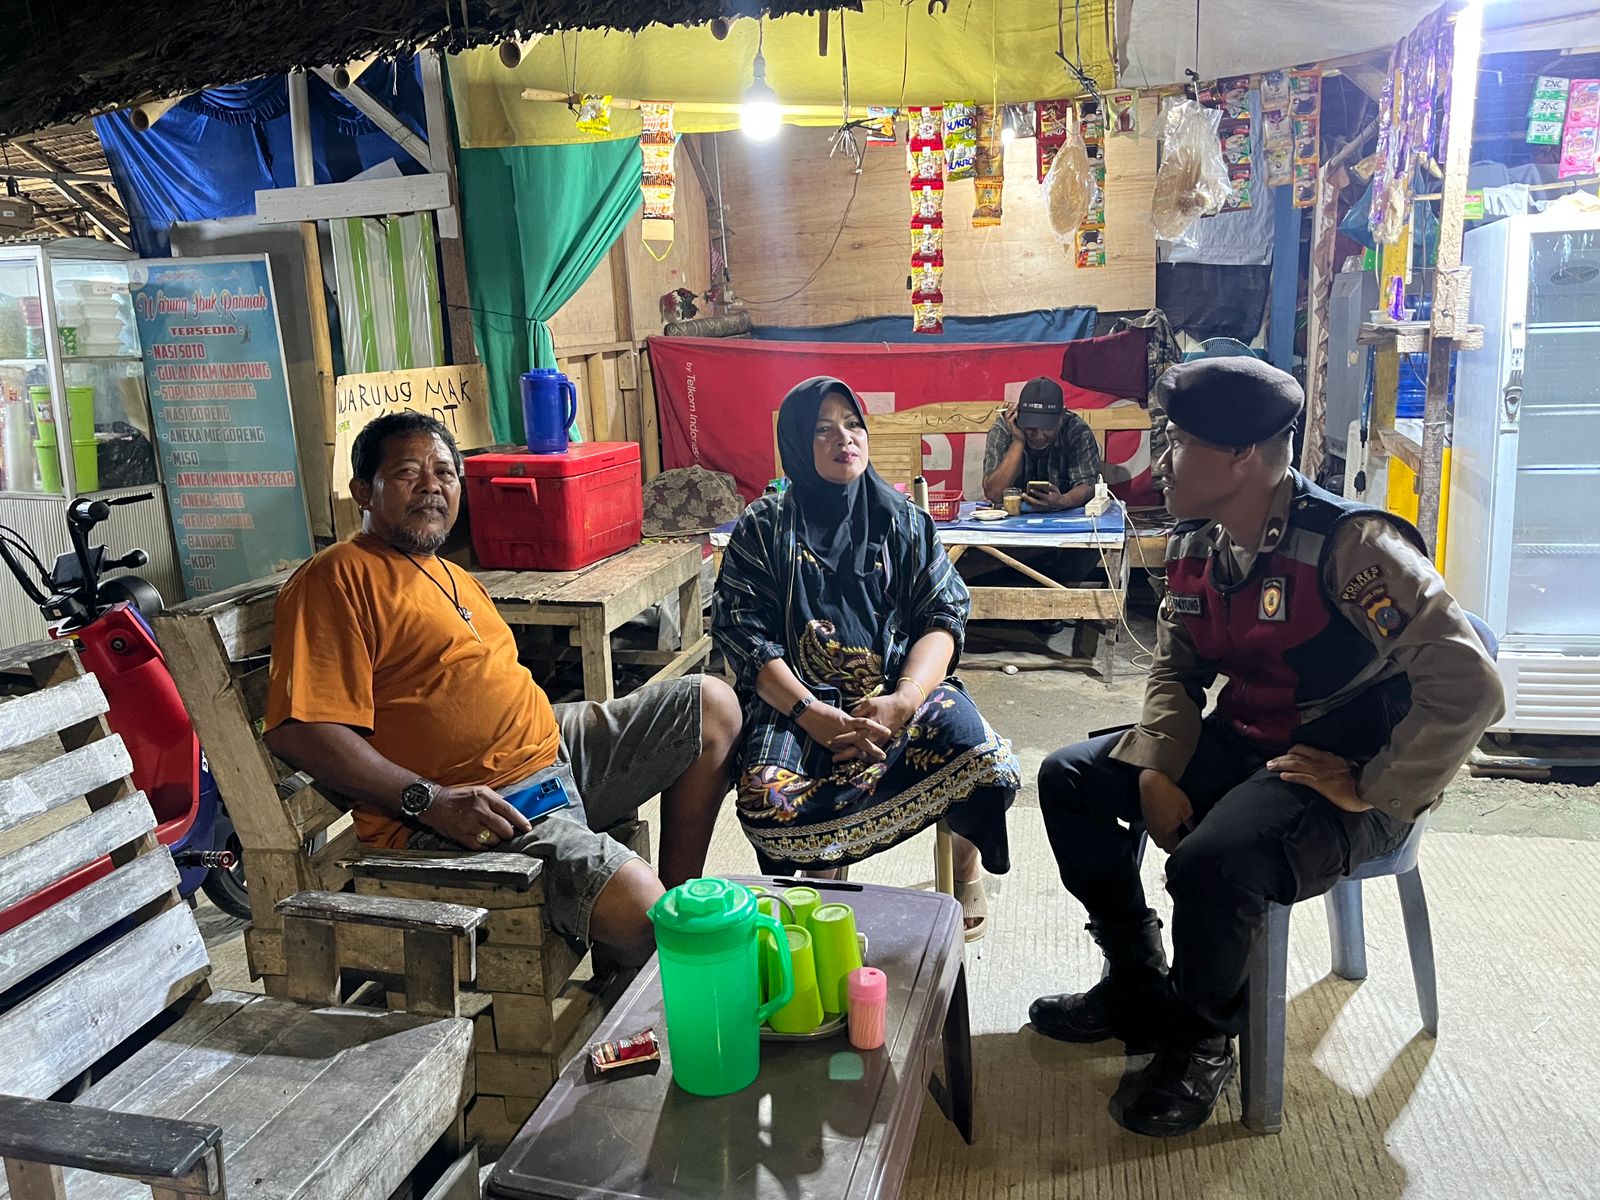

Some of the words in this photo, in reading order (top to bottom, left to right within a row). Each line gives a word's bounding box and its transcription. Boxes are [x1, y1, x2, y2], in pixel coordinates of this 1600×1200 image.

[136, 290, 188, 321] Warung
[169, 326, 237, 336] TERSEDIA
[153, 343, 177, 359] NASI
[179, 343, 206, 359] SOTO
[156, 364, 188, 380] GULAI
[189, 363, 217, 380] AYAM
[219, 362, 271, 379] KAMPUNG
[685, 362, 693, 373] by
[161, 385, 182, 400] SOP
[209, 383, 257, 399] KAMBING
[338, 382, 411, 414] WARUNG
[425, 372, 472, 405] MAK
[686, 375, 696, 412] Telkom
[165, 407, 189, 421] NASI
[190, 406, 230, 421] GORENG
[169, 428, 201, 443] ANEKA
[203, 428, 221, 442] MIE
[221, 427, 265, 442] GORENG
[690, 414, 701, 463] Indones
[173, 451, 199, 466] MISO
[178, 472, 210, 487] ANEKA
[210, 472, 260, 487] MINUMAN
[261, 471, 296, 487] SEGAR
[181, 493, 212, 508] ANEKA
[188, 534, 236, 549] BANDREK
[190, 555, 216, 569] KOPI
[195, 577, 213, 591] DLL
[1342, 566, 1378, 600] POLRES
